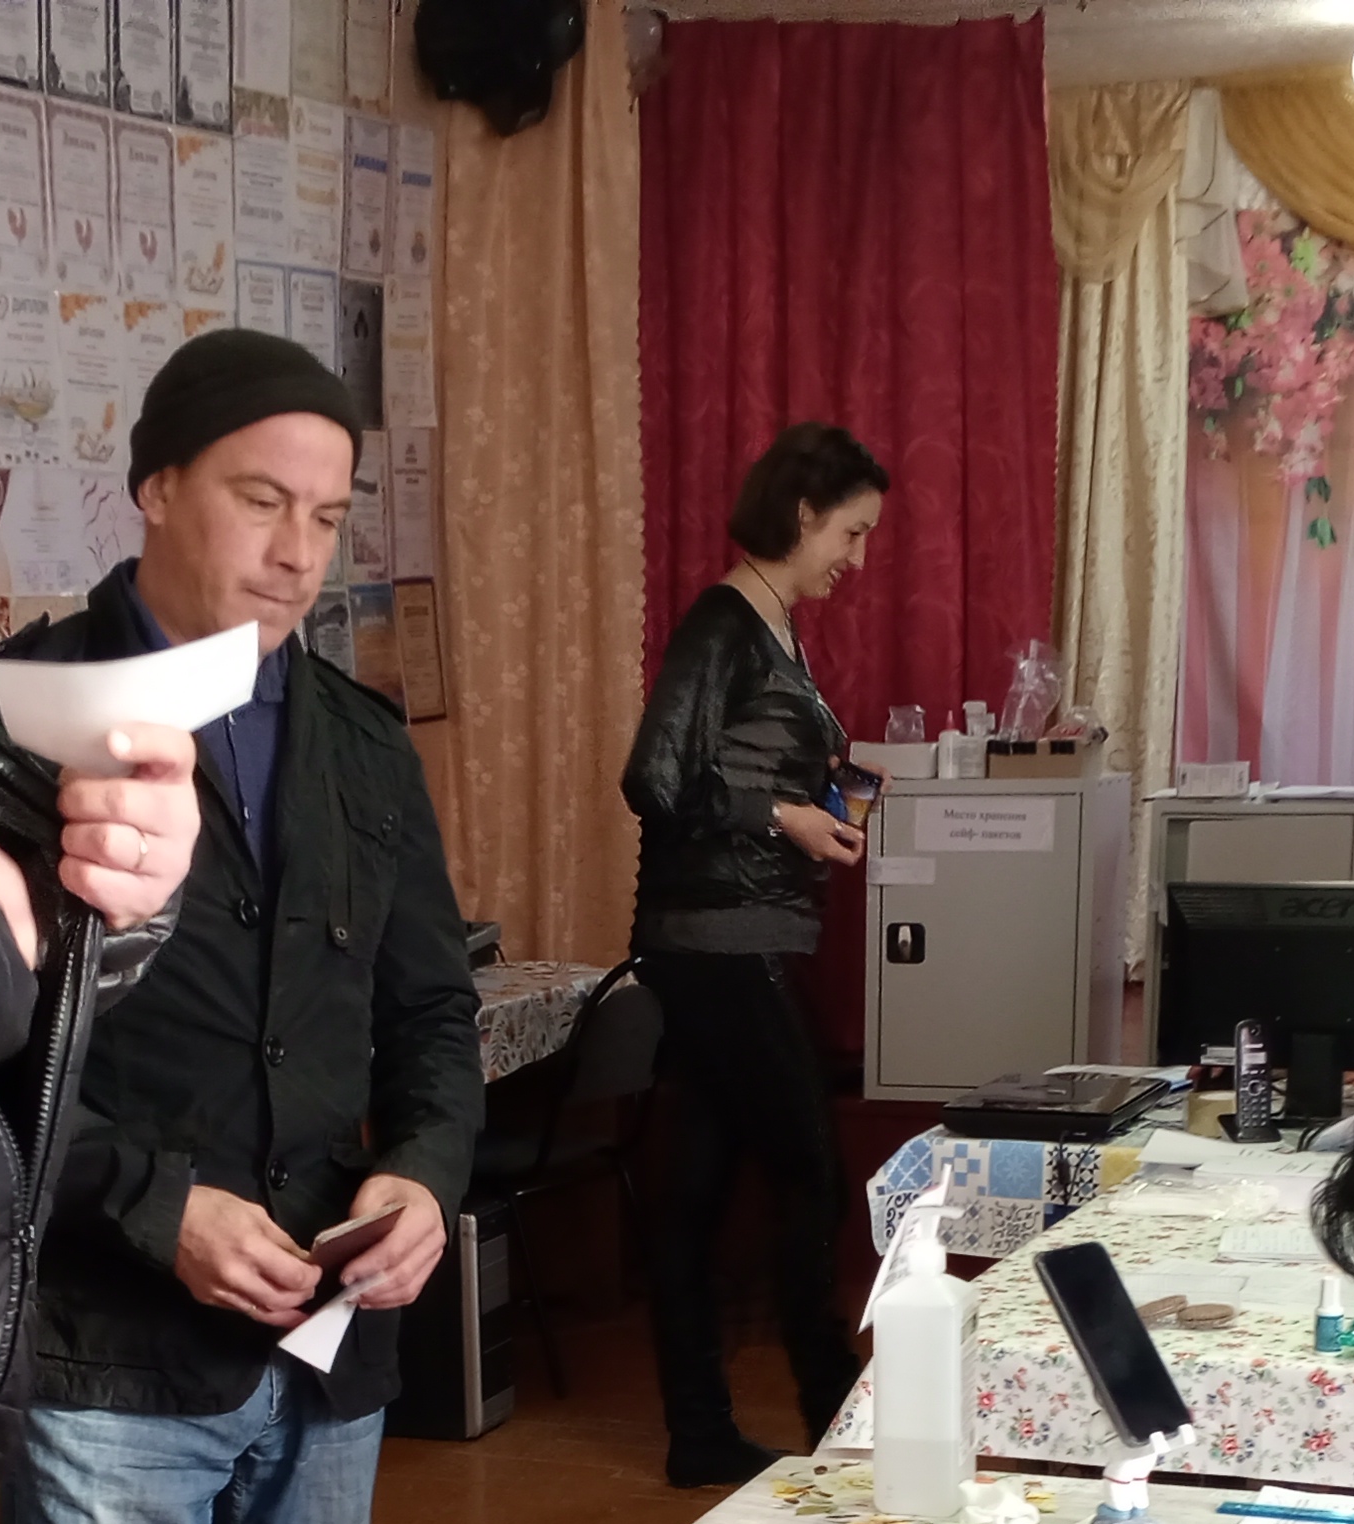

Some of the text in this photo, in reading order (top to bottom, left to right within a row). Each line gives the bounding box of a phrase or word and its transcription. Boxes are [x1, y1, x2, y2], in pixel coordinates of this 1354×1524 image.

[943, 808, 1027, 823] Место хранения
[981, 830, 1022, 840] пакетов
